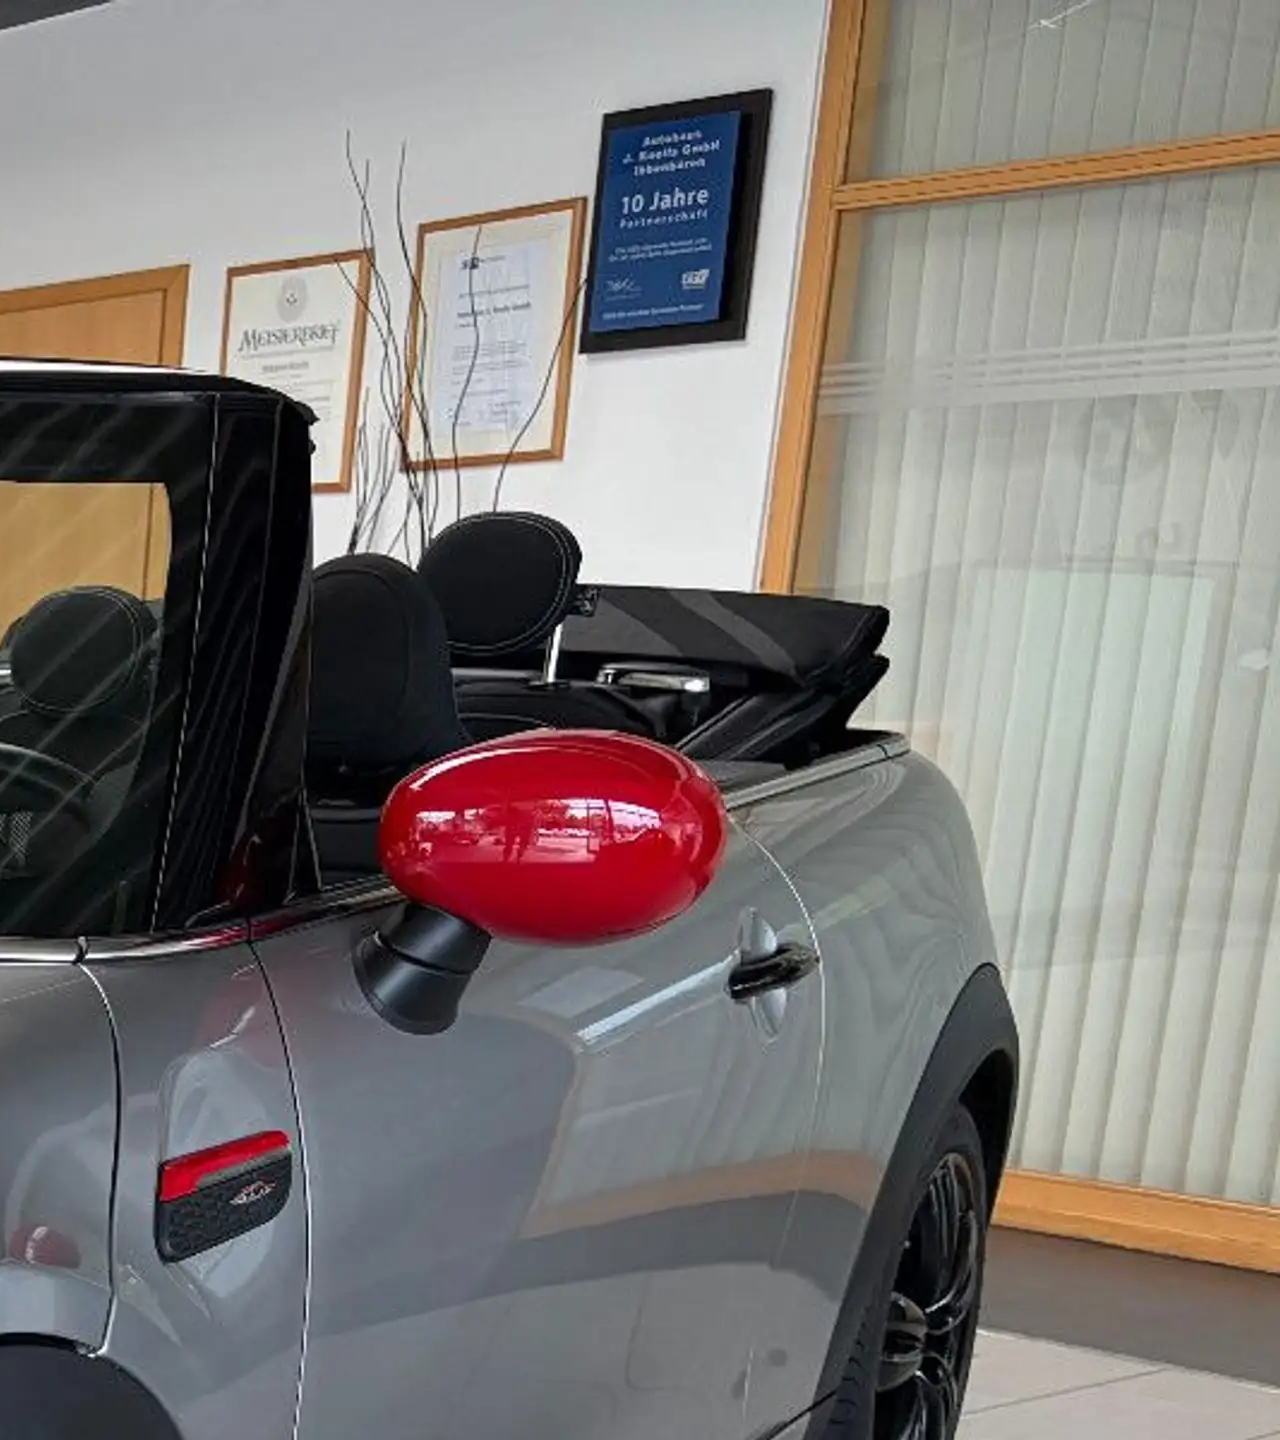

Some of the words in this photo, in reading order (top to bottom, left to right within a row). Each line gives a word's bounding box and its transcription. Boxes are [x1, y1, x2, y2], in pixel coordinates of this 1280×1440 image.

[621, 194, 644, 215] 10
[649, 186, 710, 211] Jahre
[619, 209, 709, 229] Partnerschaft
